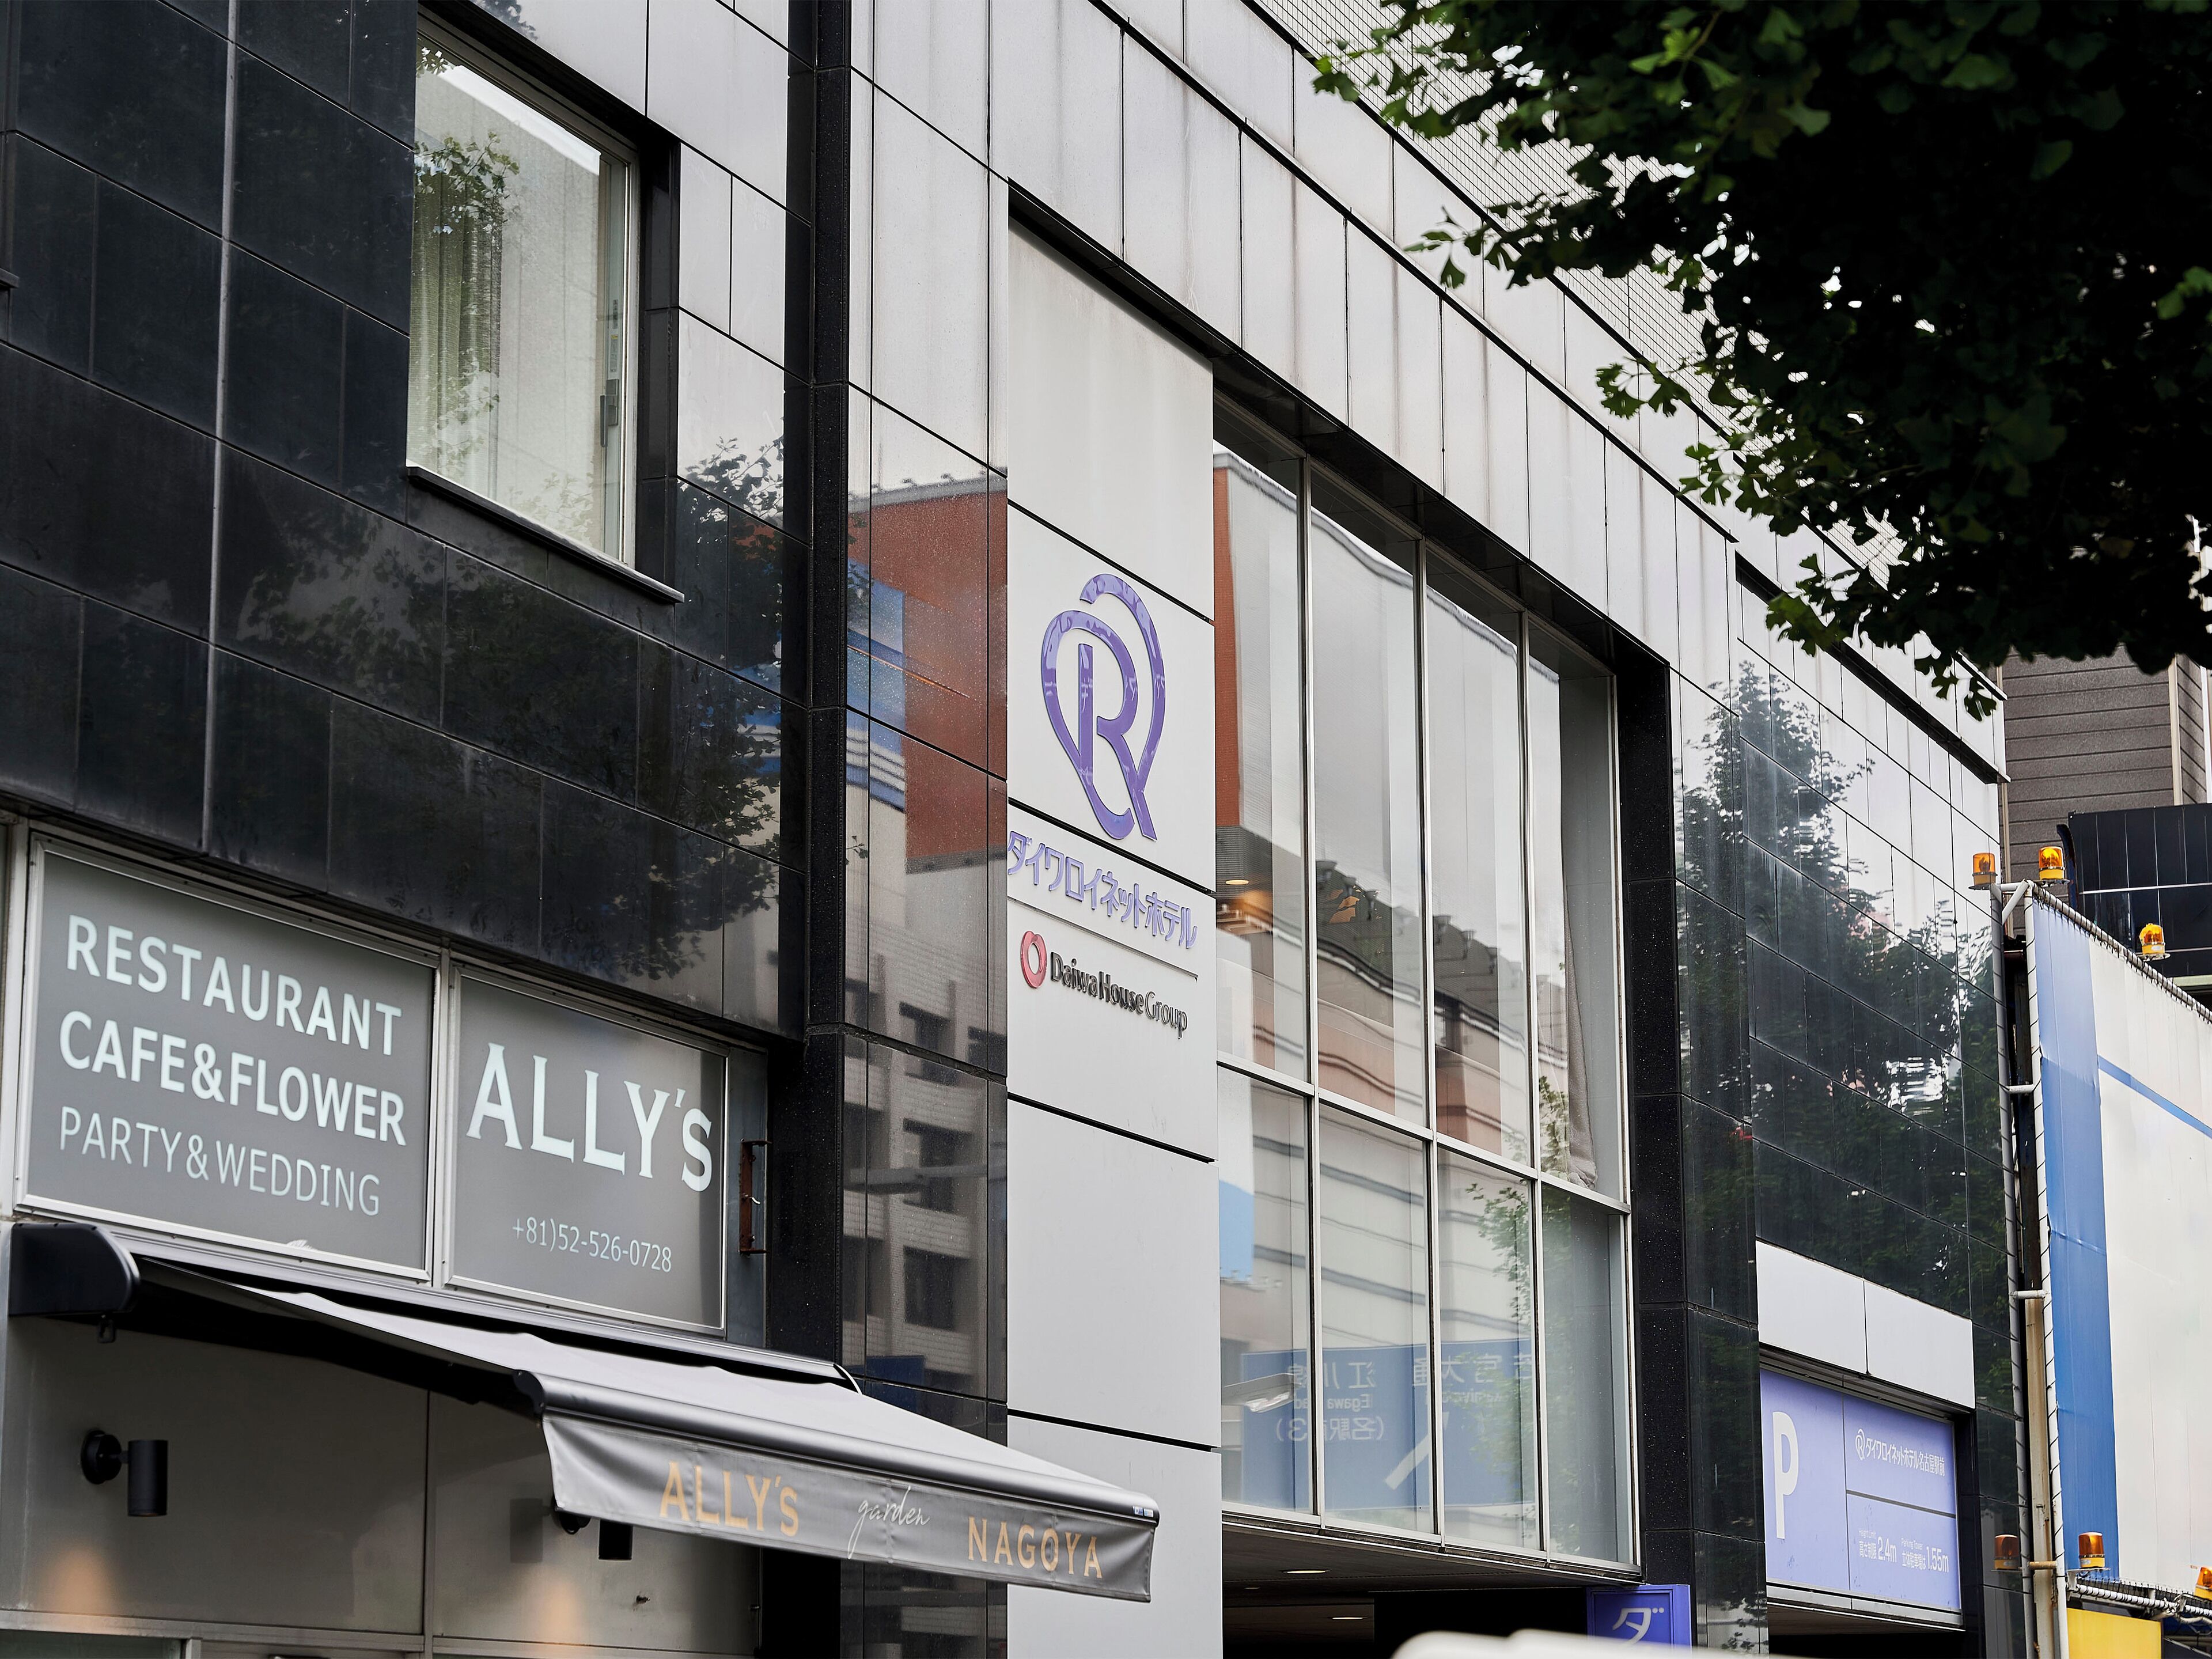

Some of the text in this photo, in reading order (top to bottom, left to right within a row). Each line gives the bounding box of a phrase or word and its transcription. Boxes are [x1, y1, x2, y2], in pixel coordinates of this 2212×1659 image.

[1008, 831, 1198, 949] ダイワロイネットホテル
[67, 915, 402, 1055] RESTAURANT
[59, 1011, 406, 1146] CAFE&FLOWER
[512, 1217, 672, 1272] +81)52-526-0728
[1772, 1411, 1799, 1539] P
[1866, 1438, 1945, 1476] ダイワロイネットホテル名古屋駅前
[848, 1484, 930, 1559] garden
[968, 1516, 1103, 1578] NAGOYA
[1877, 1536, 1896, 1563] 2.4m
[1926, 1546, 1949, 1573] 1.55m
[1613, 1607, 1665, 1645] ダ
